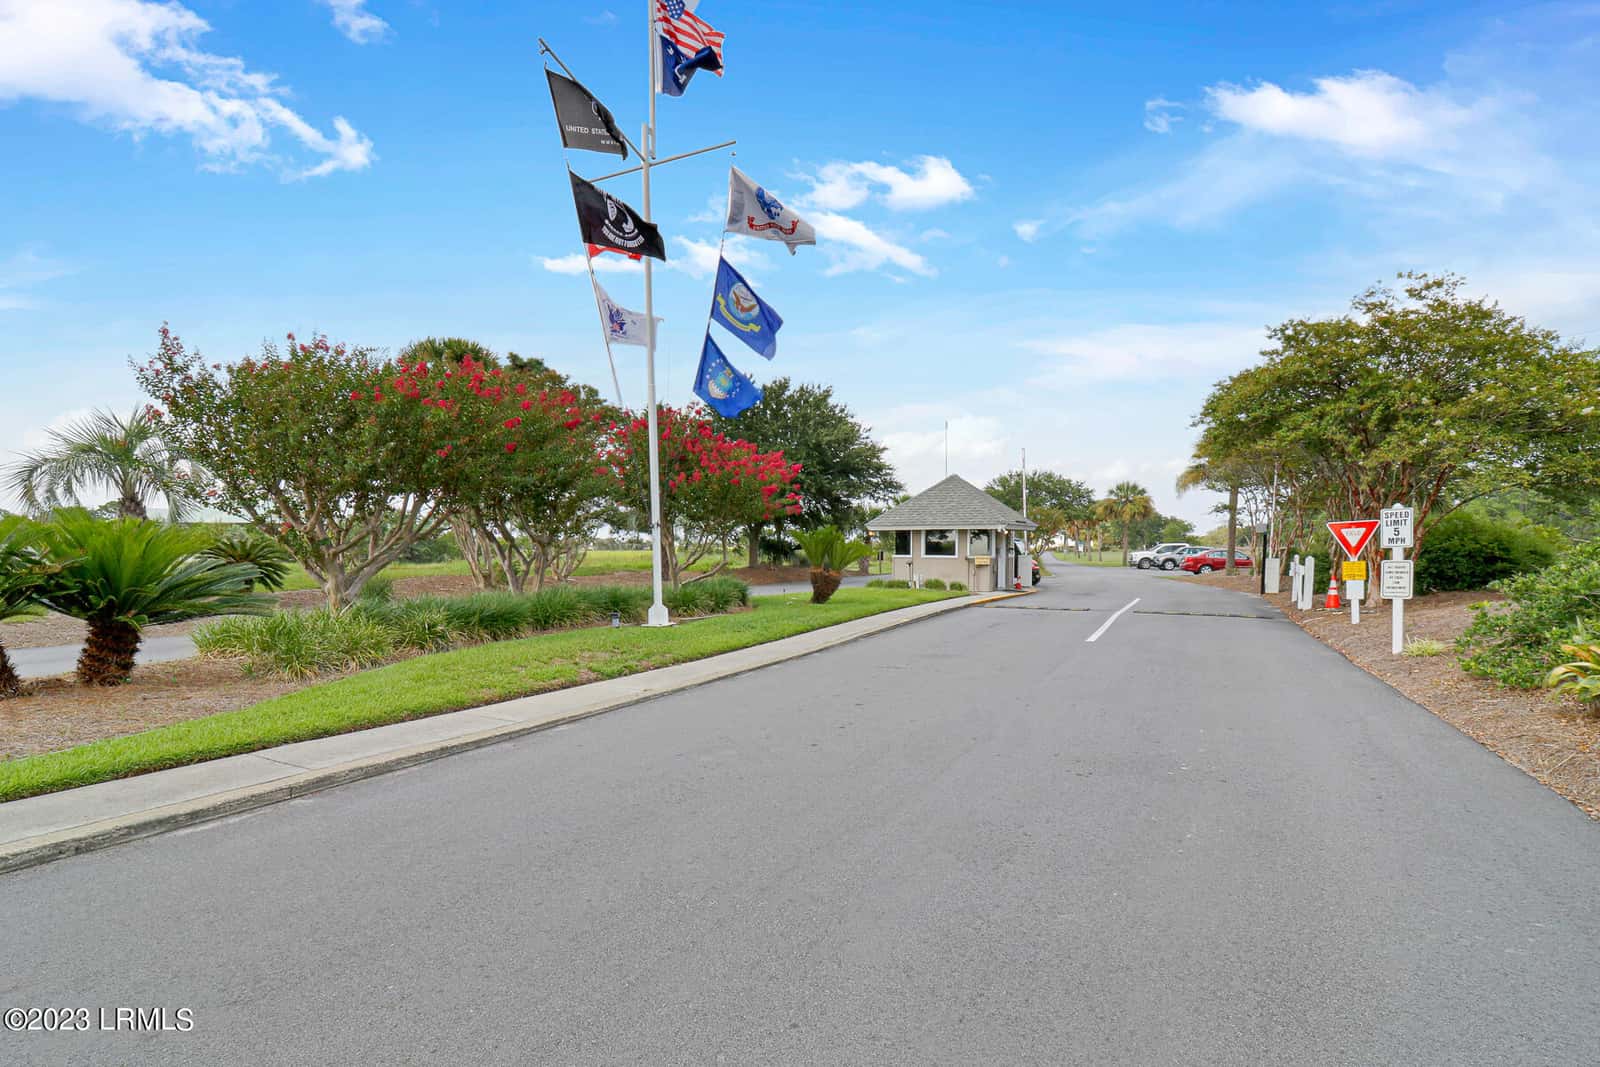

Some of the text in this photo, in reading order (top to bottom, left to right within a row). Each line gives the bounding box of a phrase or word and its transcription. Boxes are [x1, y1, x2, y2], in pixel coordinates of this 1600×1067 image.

[565, 124, 589, 134] UNITED
[1384, 511, 1409, 519] SPEED
[1385, 519, 1408, 527] LIMIT
[1393, 527, 1400, 536] 5
[1388, 537, 1406, 545] MPH
